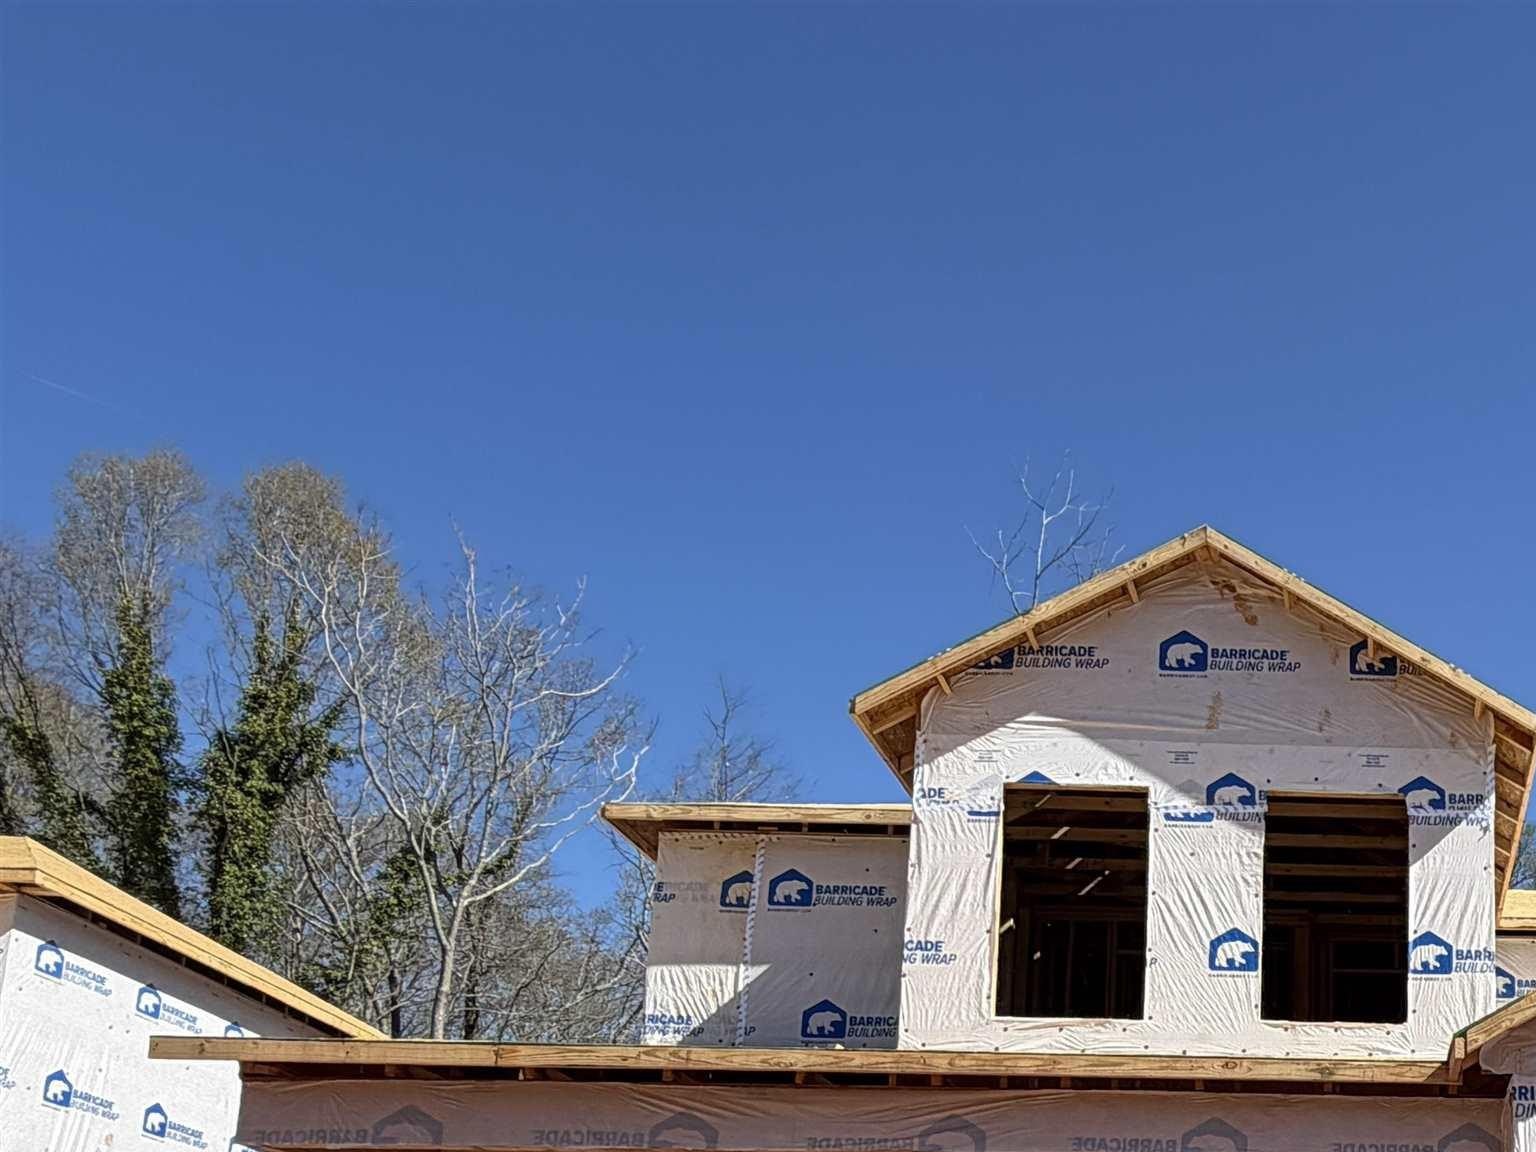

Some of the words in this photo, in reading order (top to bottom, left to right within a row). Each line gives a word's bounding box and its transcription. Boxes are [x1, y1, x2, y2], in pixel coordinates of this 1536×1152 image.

[1017, 645, 1096, 657] BARRICADE
[1211, 648, 1288, 660] BARRICADE
[1016, 657, 1071, 669] BUILDING
[1075, 657, 1109, 669] WRAP
[1210, 660, 1263, 672] BUILDING
[1268, 661, 1300, 673] WRAP
[816, 885, 886, 896] BARRICADE
[814, 896, 864, 906] BUILDING
[866, 898, 897, 907] WRAP
[921, 954, 956, 964] WRAP
